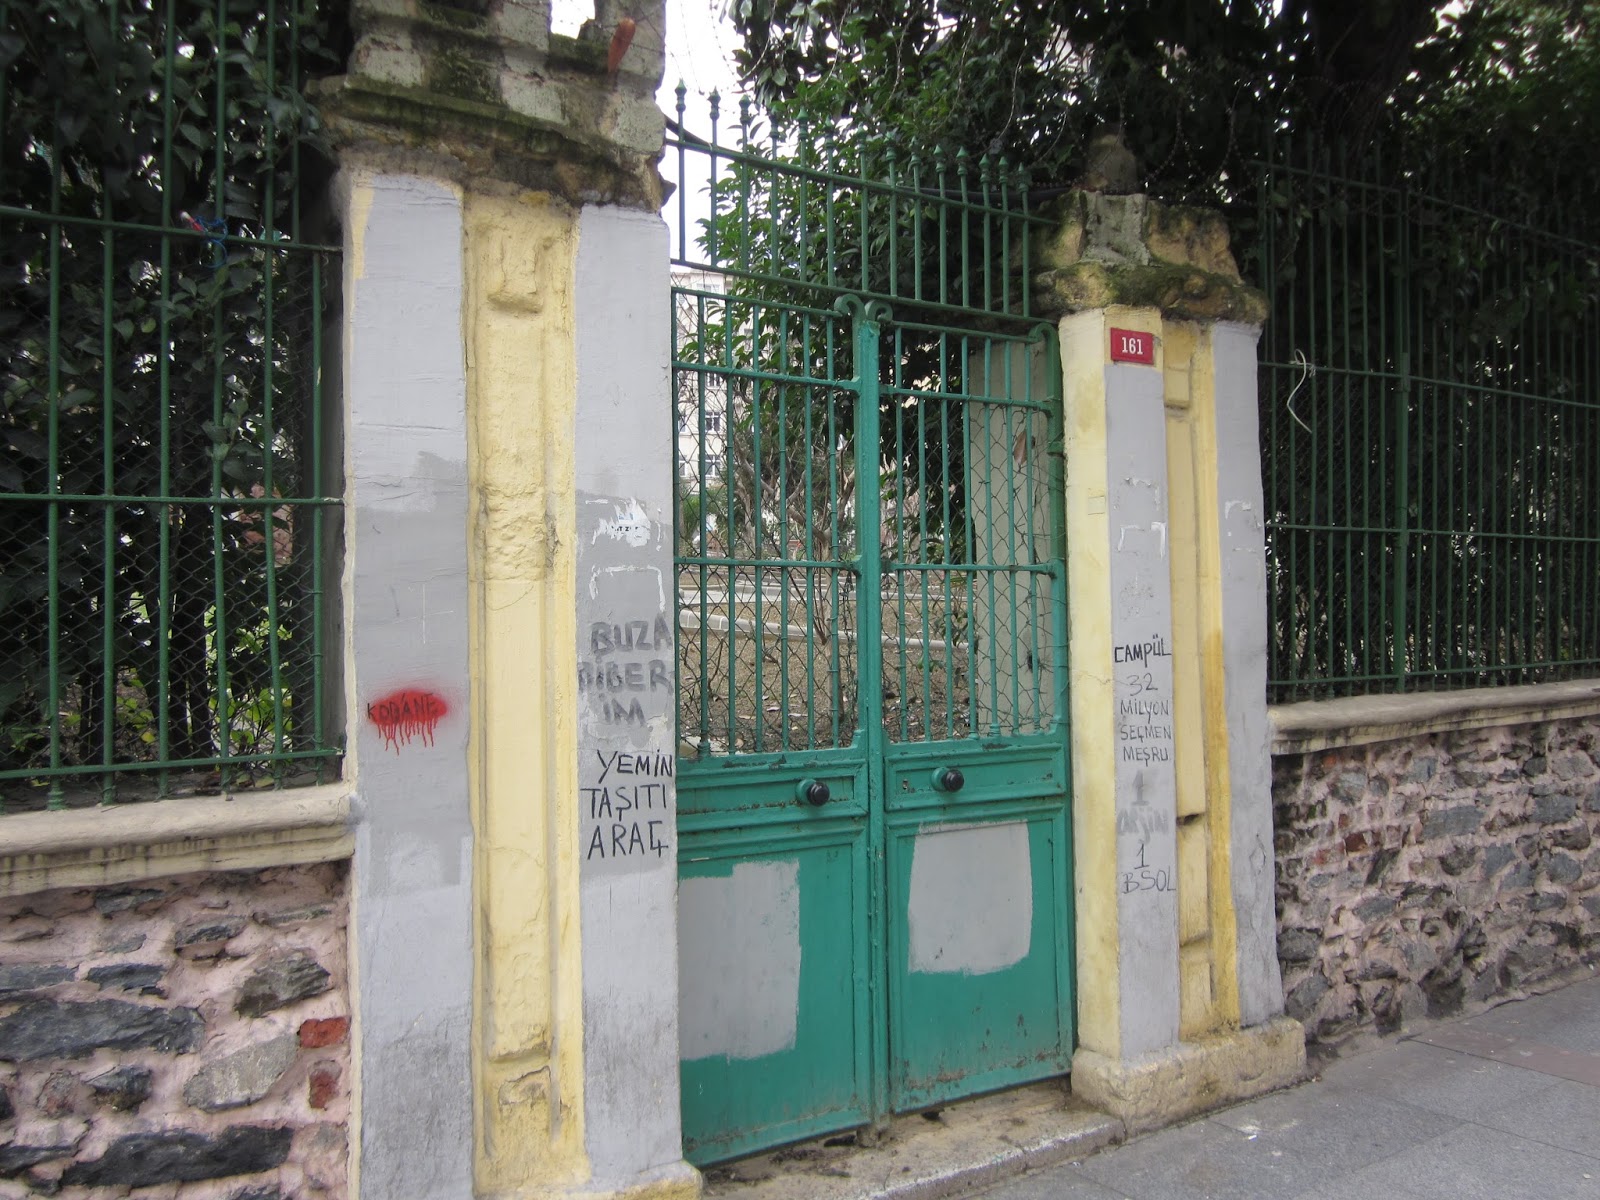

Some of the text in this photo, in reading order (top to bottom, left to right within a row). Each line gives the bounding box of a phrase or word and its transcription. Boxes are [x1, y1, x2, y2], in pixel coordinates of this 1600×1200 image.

[1121, 336, 1144, 355] 161
[1126, 672, 1158, 697] 32
[1120, 698, 1169, 724] MİLYON
[1120, 724, 1172, 743] SEÇMEN
[597, 748, 673, 784] YEMİN
[1123, 746, 1169, 767] MEŞRU
[579, 784, 667, 822] TAŞITI
[587, 820, 669, 860] ARAÇ
[1134, 843, 1150, 870] 1
